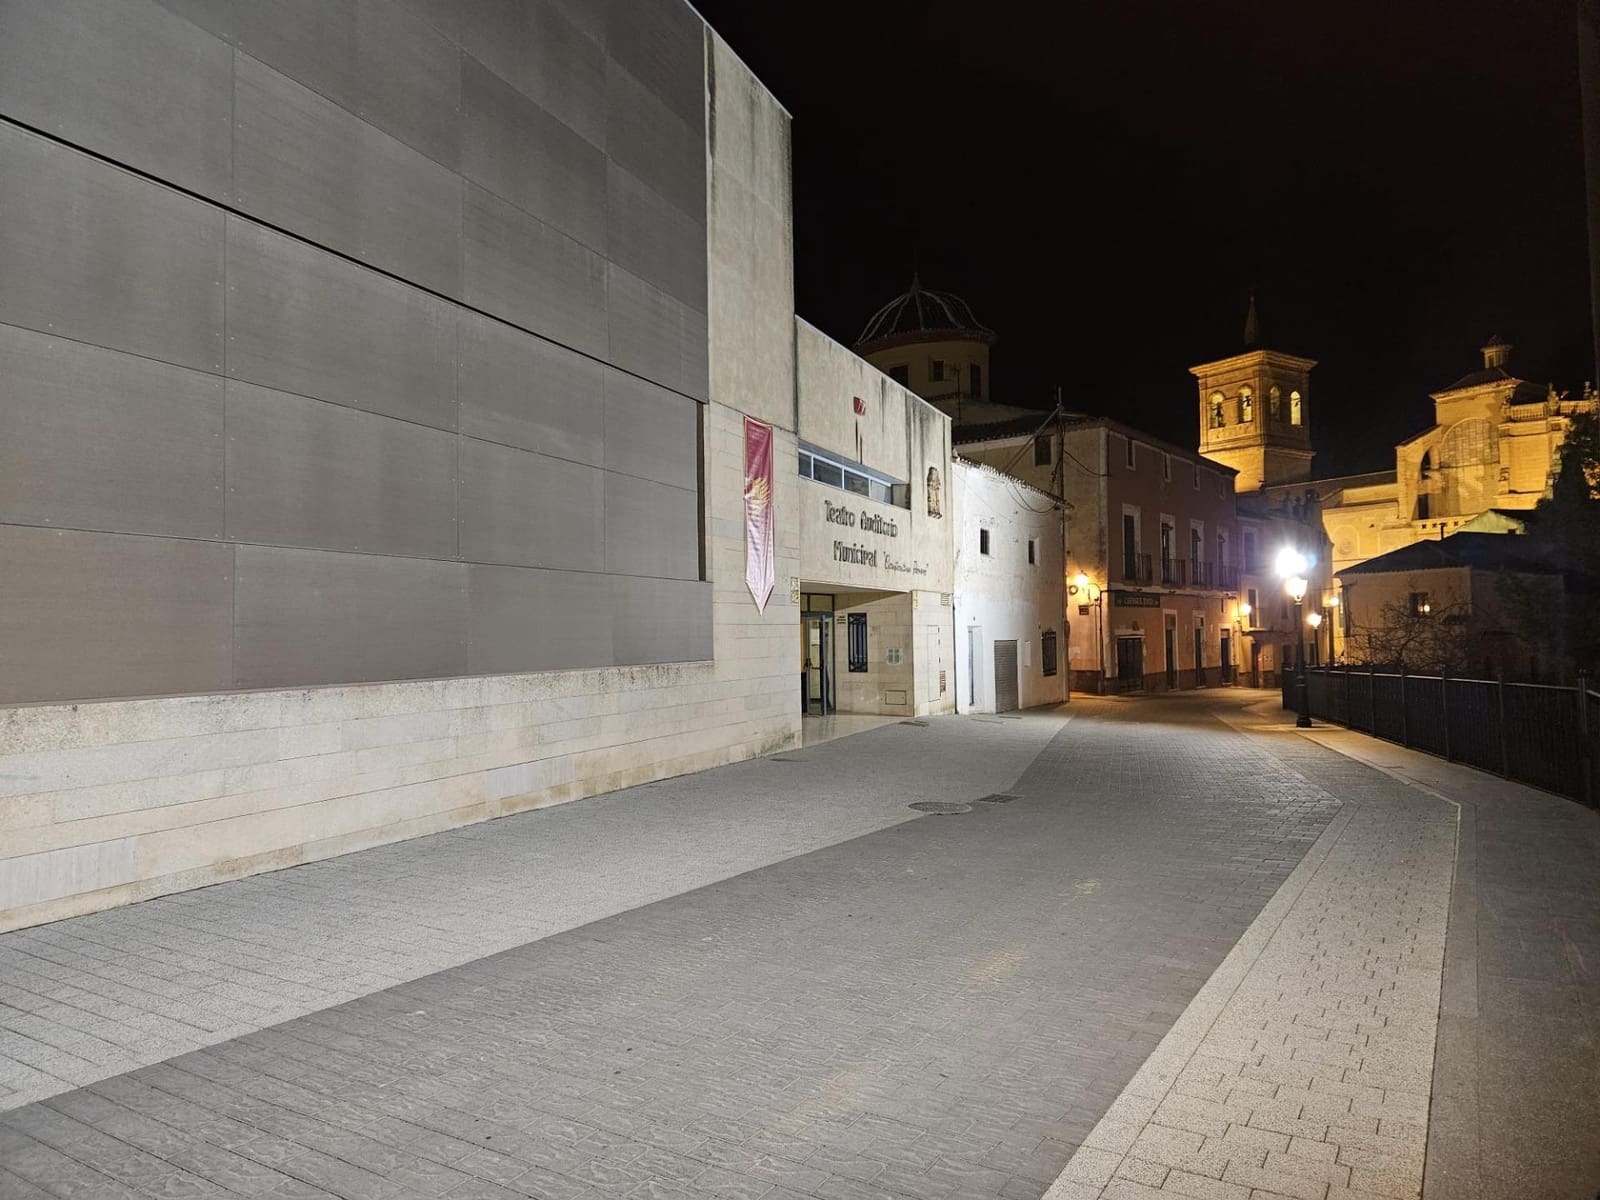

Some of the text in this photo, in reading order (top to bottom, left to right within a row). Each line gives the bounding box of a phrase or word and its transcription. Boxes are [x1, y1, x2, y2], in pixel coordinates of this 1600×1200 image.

[825, 500, 898, 538] Teatro Auditorio
[834, 540, 878, 568] Municipal
